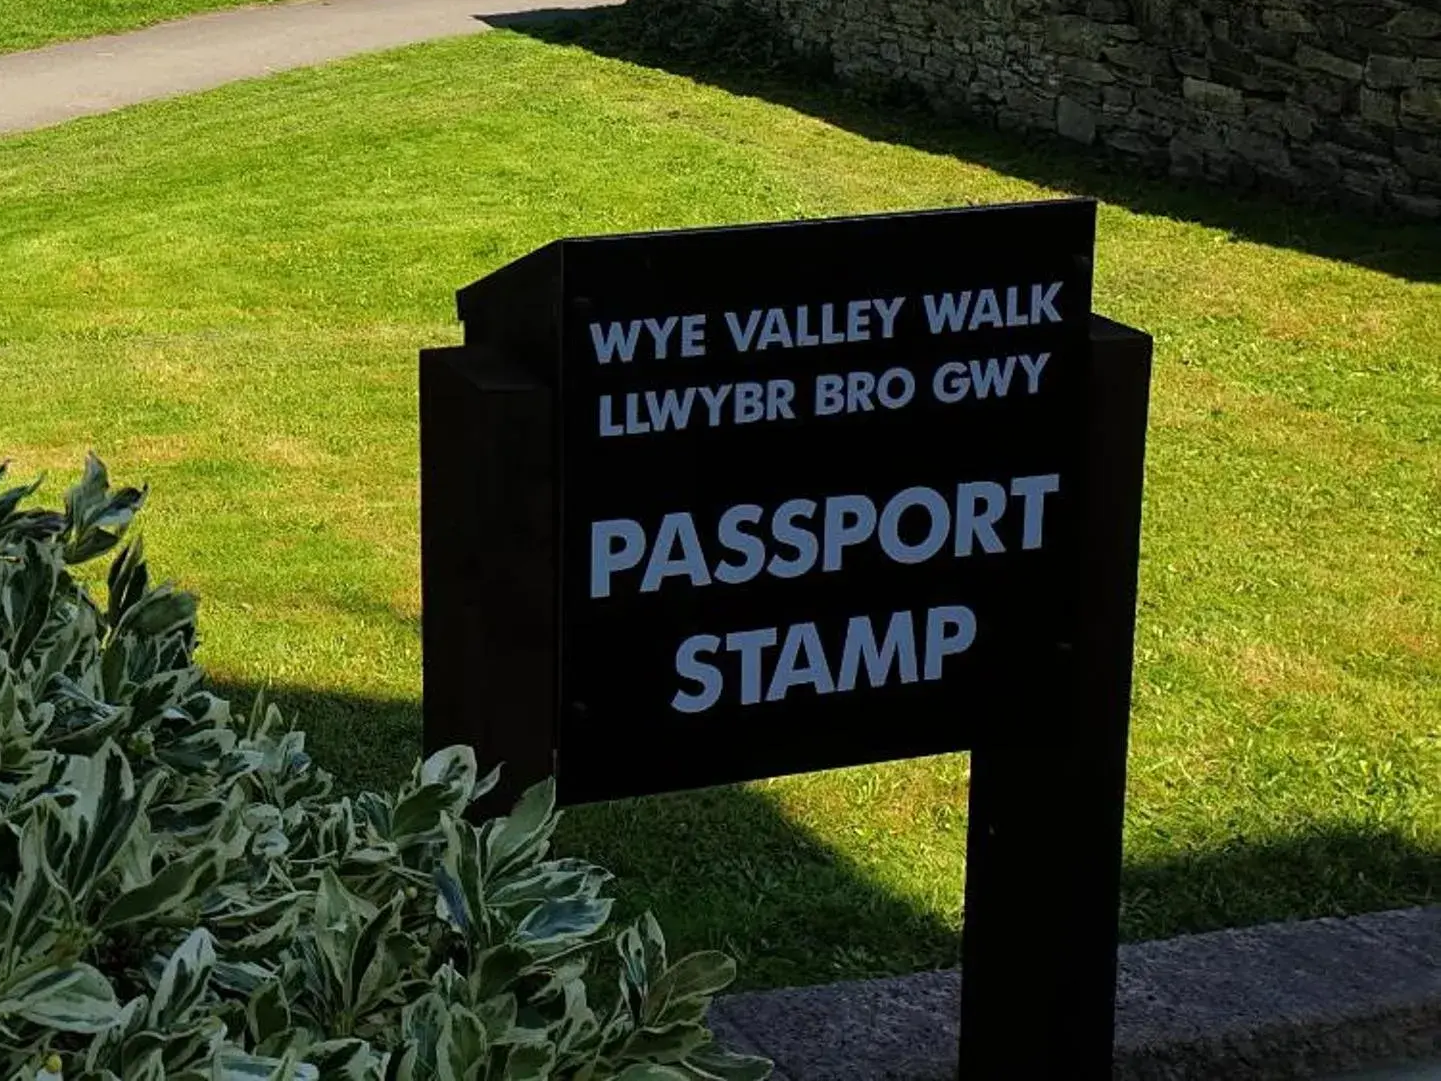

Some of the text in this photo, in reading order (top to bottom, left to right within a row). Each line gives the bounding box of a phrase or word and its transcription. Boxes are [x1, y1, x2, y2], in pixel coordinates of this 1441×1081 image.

[589, 281, 1063, 365] WYE VALLEY WALK
[599, 352, 1051, 437] LLWYBR BRO GWY
[590, 473, 1060, 599] PASSPORT
[670, 605, 977, 713] STAMP
